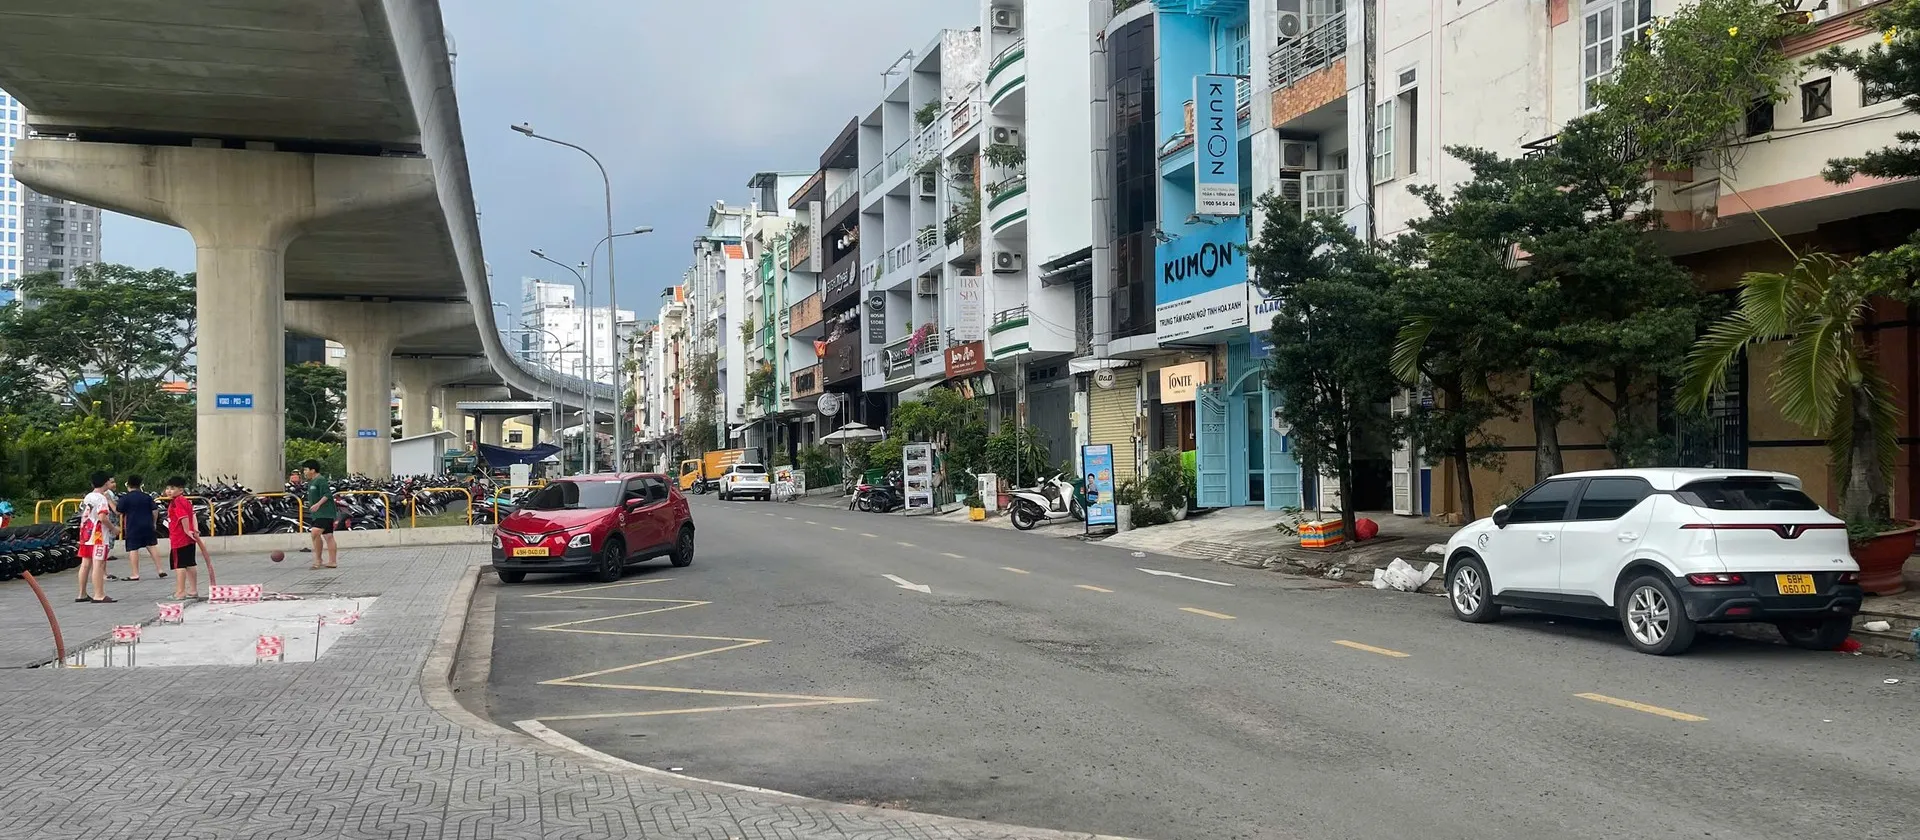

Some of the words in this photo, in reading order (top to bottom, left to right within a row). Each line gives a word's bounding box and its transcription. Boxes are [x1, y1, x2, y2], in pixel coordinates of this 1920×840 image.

[1208, 84, 1227, 174] KUMON
[1165, 242, 1232, 284] KUMON
[1160, 318, 1173, 327] TRUNG
[1174, 314, 1182, 324] TÂM
[1183, 311, 1195, 321] NGOẠI
[1197, 307, 1206, 318] NGỮ
[1207, 306, 1218, 316] TINH
[1218, 304, 1228, 313] HOA
[1228, 301, 1242, 311] XANH
[1786, 574, 1804, 584] 68H
